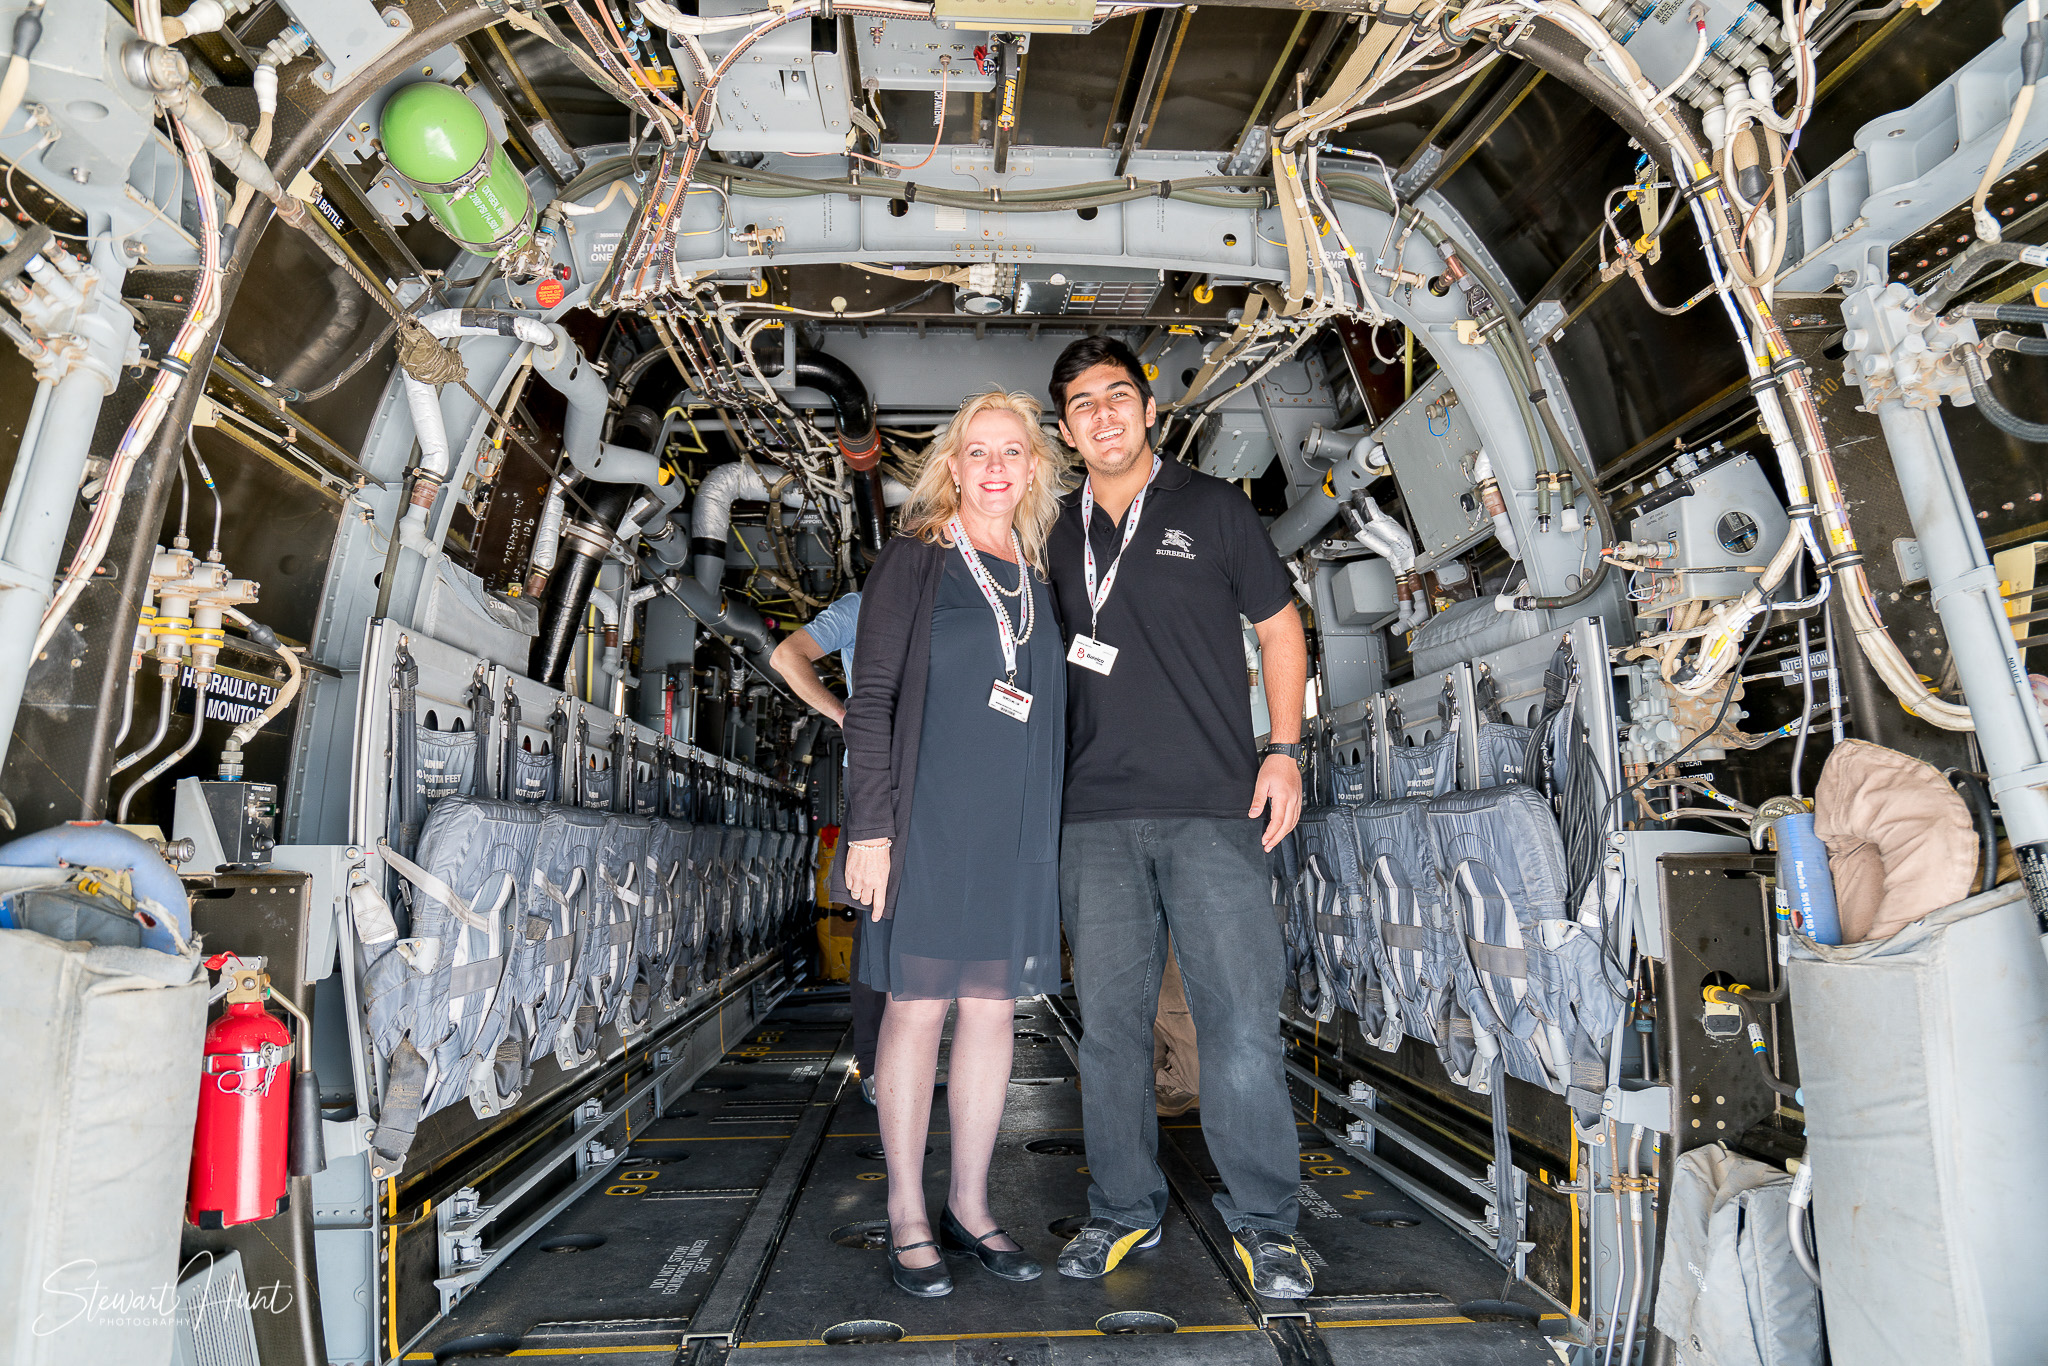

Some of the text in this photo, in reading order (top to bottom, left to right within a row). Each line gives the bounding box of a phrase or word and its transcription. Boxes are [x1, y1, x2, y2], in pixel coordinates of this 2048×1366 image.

[319, 198, 344, 230] BOTTLE
[1156, 548, 1196, 560] BURBERRY
[1781, 652, 1829, 671] INTEHON
[181, 666, 258, 701] HRAULIC
[445, 774, 461, 783] FEET
[649, 1246, 690, 1288] DO NOT STOW
[661, 1240, 710, 1294] EQUIPMENT UNDER
[692, 1258, 714, 1272] SEAT
